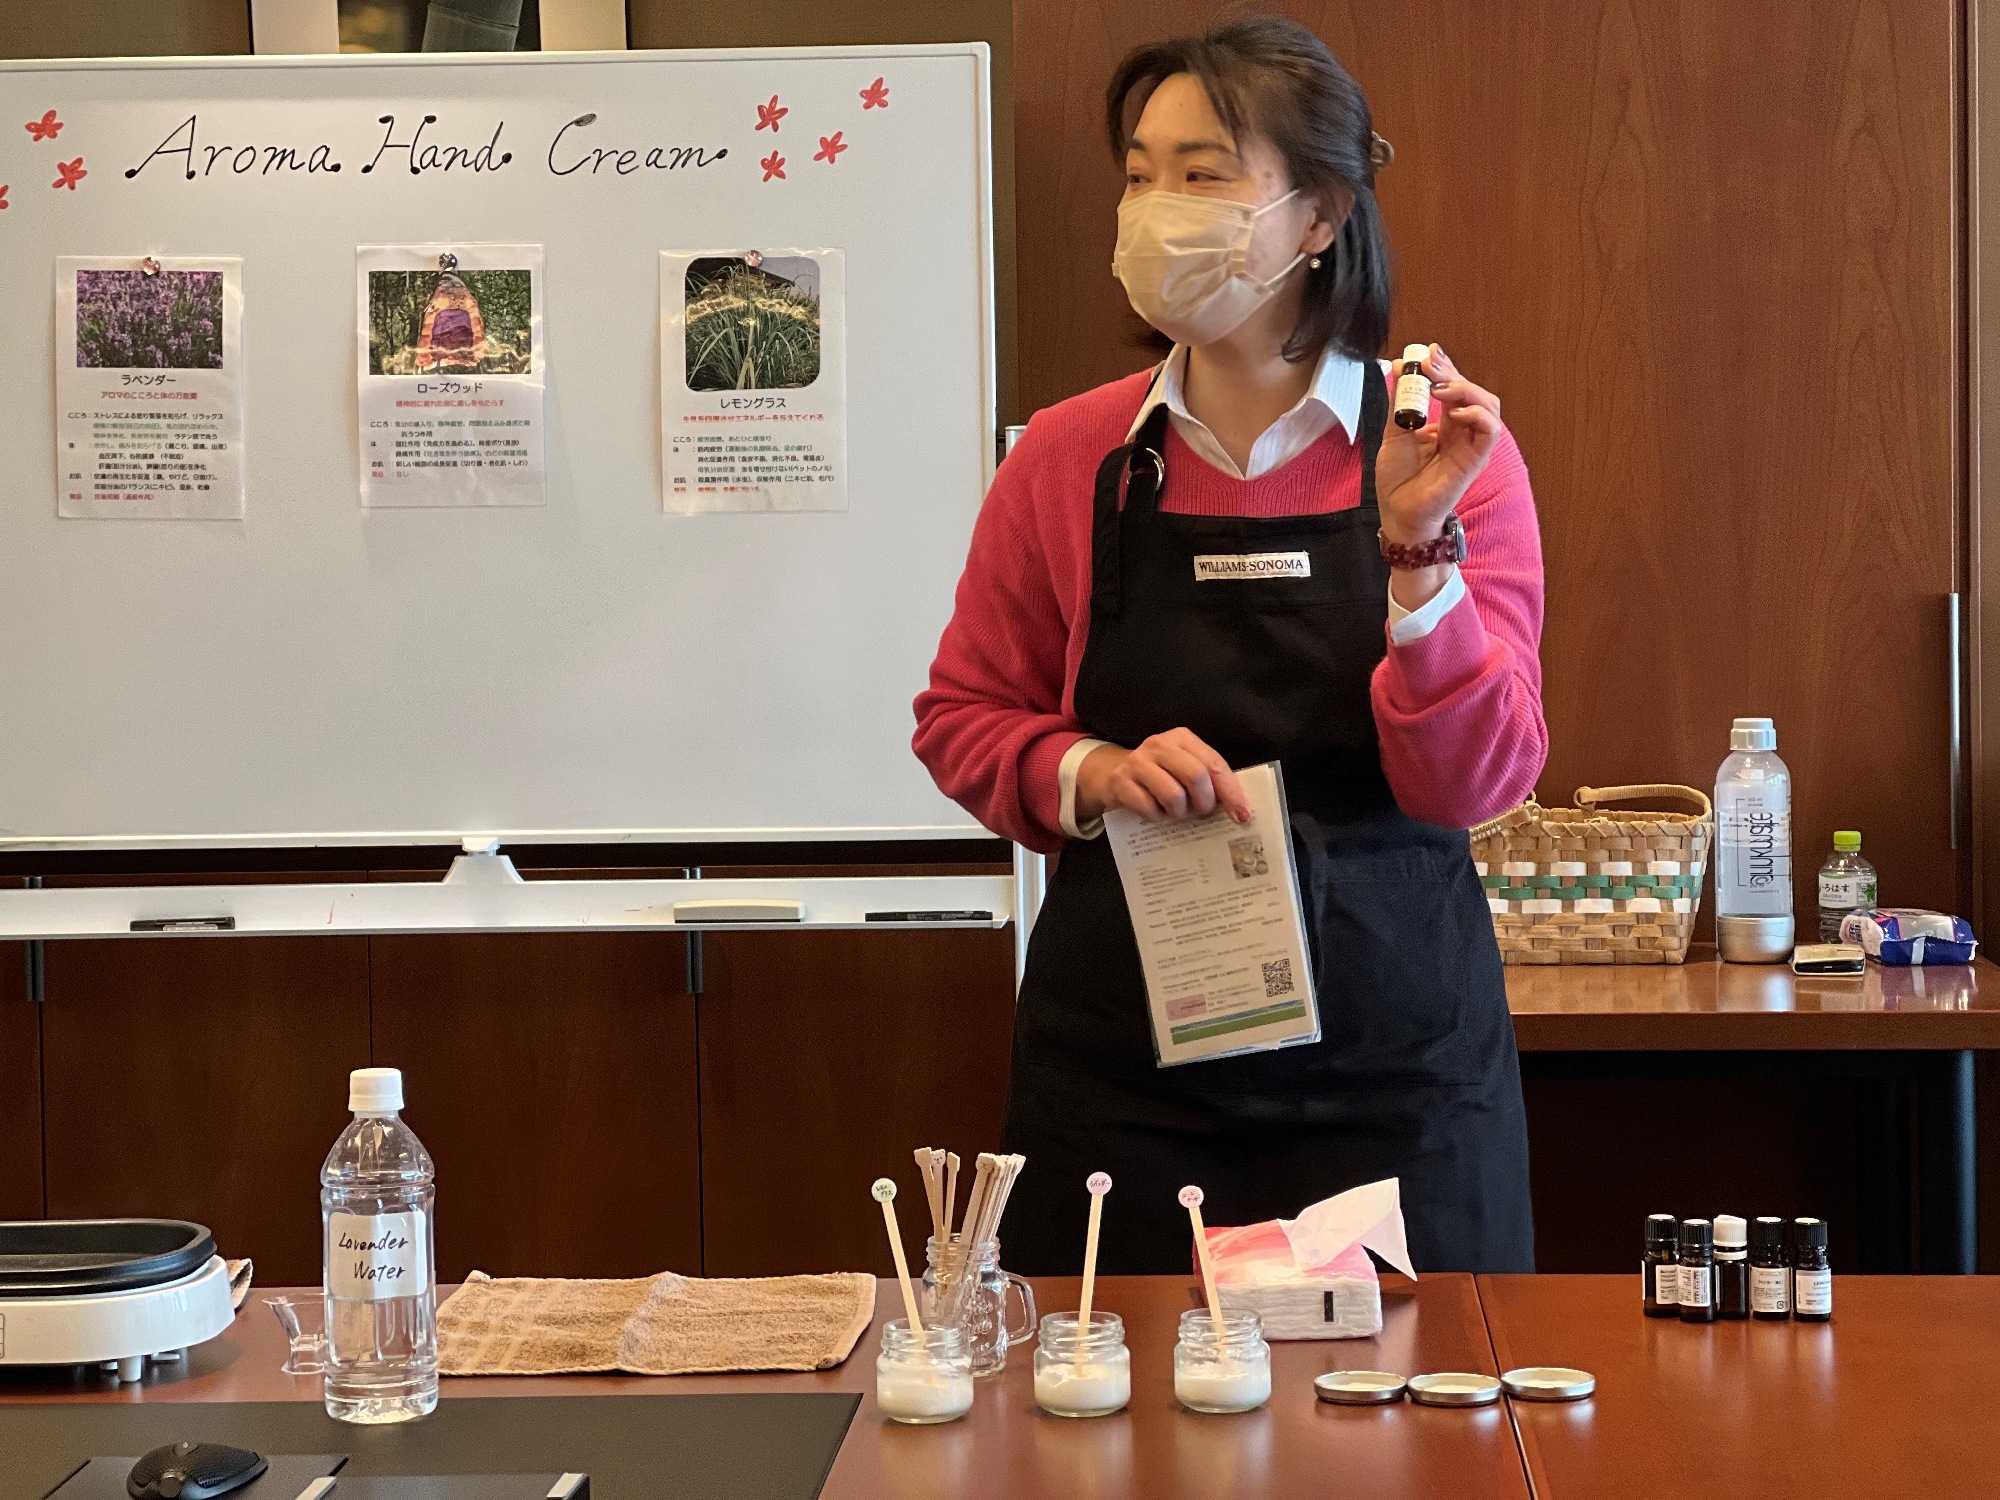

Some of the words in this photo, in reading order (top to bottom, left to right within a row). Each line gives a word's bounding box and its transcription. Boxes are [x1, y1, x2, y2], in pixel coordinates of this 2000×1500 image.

[124, 113, 342, 179] Aroma
[361, 113, 513, 176] Hand
[547, 112, 729, 177] Cream
[120, 374, 177, 386] ラベンダー
[417, 382, 484, 394] ローズウッド
[719, 397, 788, 409] レモングラス
[1198, 559, 1304, 573] WILLIAMS-SONOMA
[338, 1231, 409, 1252] Lavender
[354, 1261, 406, 1281] Water
